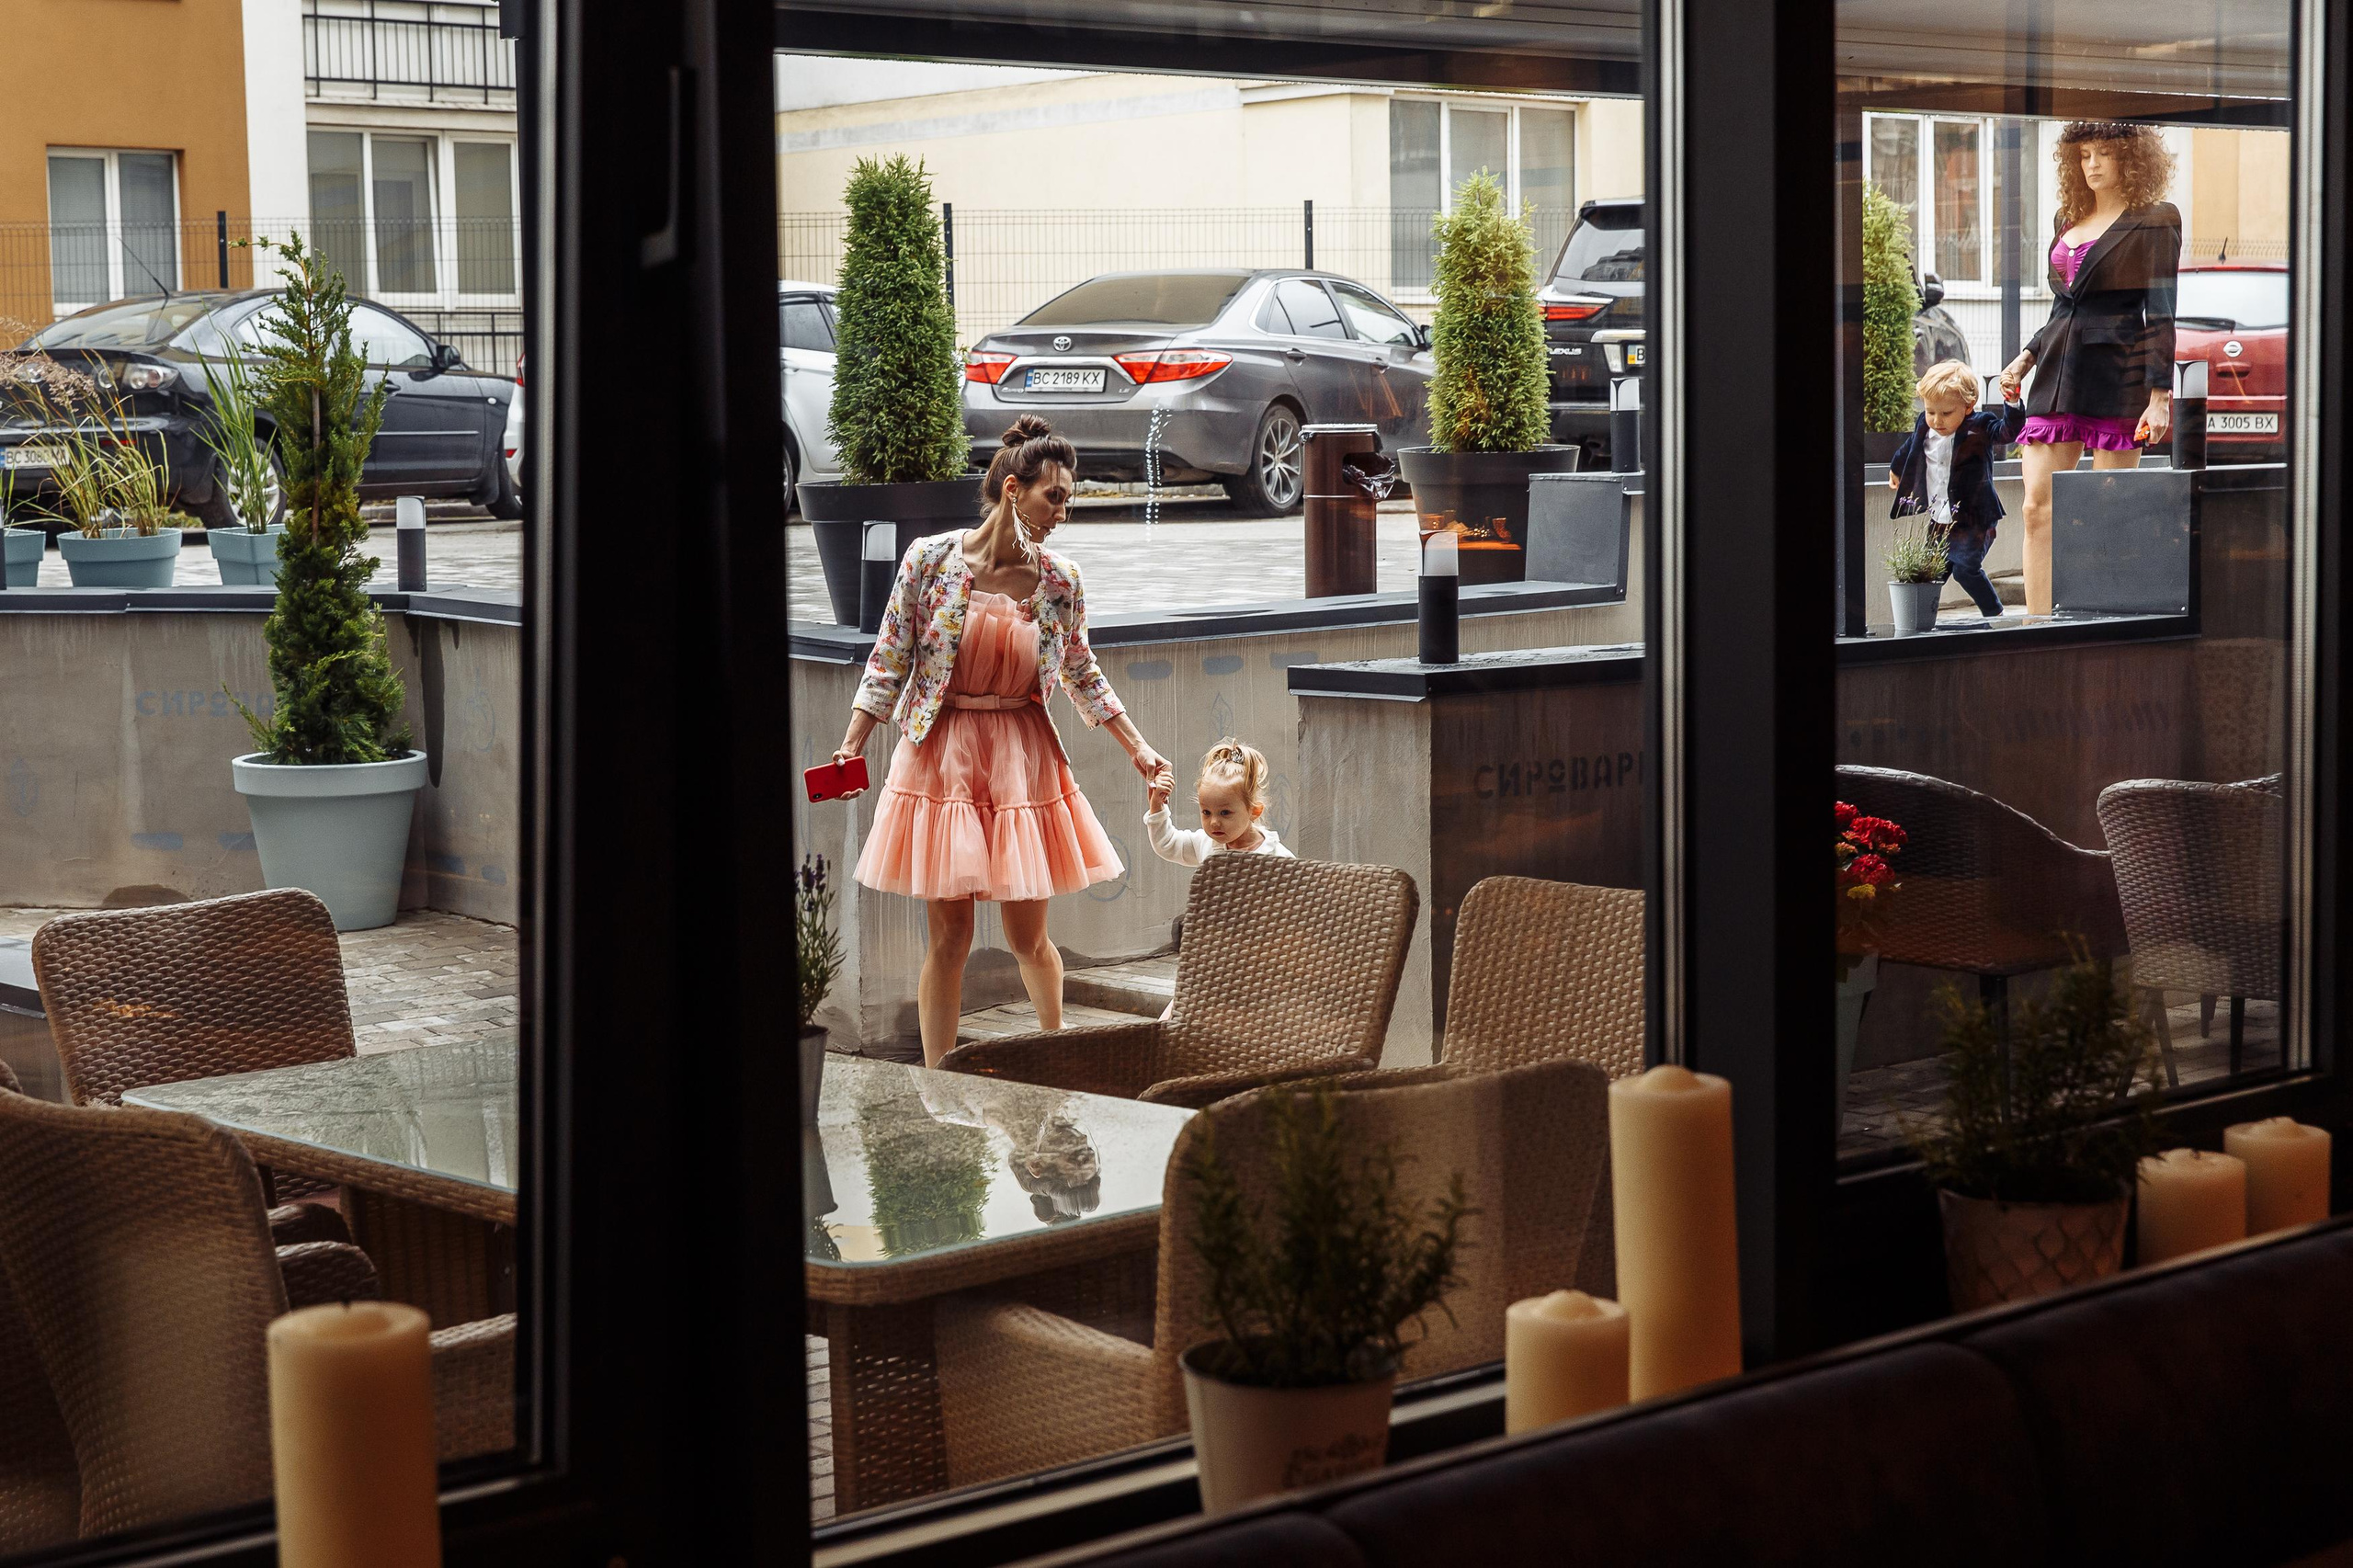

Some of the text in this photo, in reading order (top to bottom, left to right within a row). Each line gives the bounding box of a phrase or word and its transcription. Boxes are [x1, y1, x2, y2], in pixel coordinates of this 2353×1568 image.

[1033, 372, 1100, 384] BC 2189 KX
[2221, 416, 2251, 429] 3005
[2255, 416, 2274, 429] BX
[6, 450, 22, 464] BC
